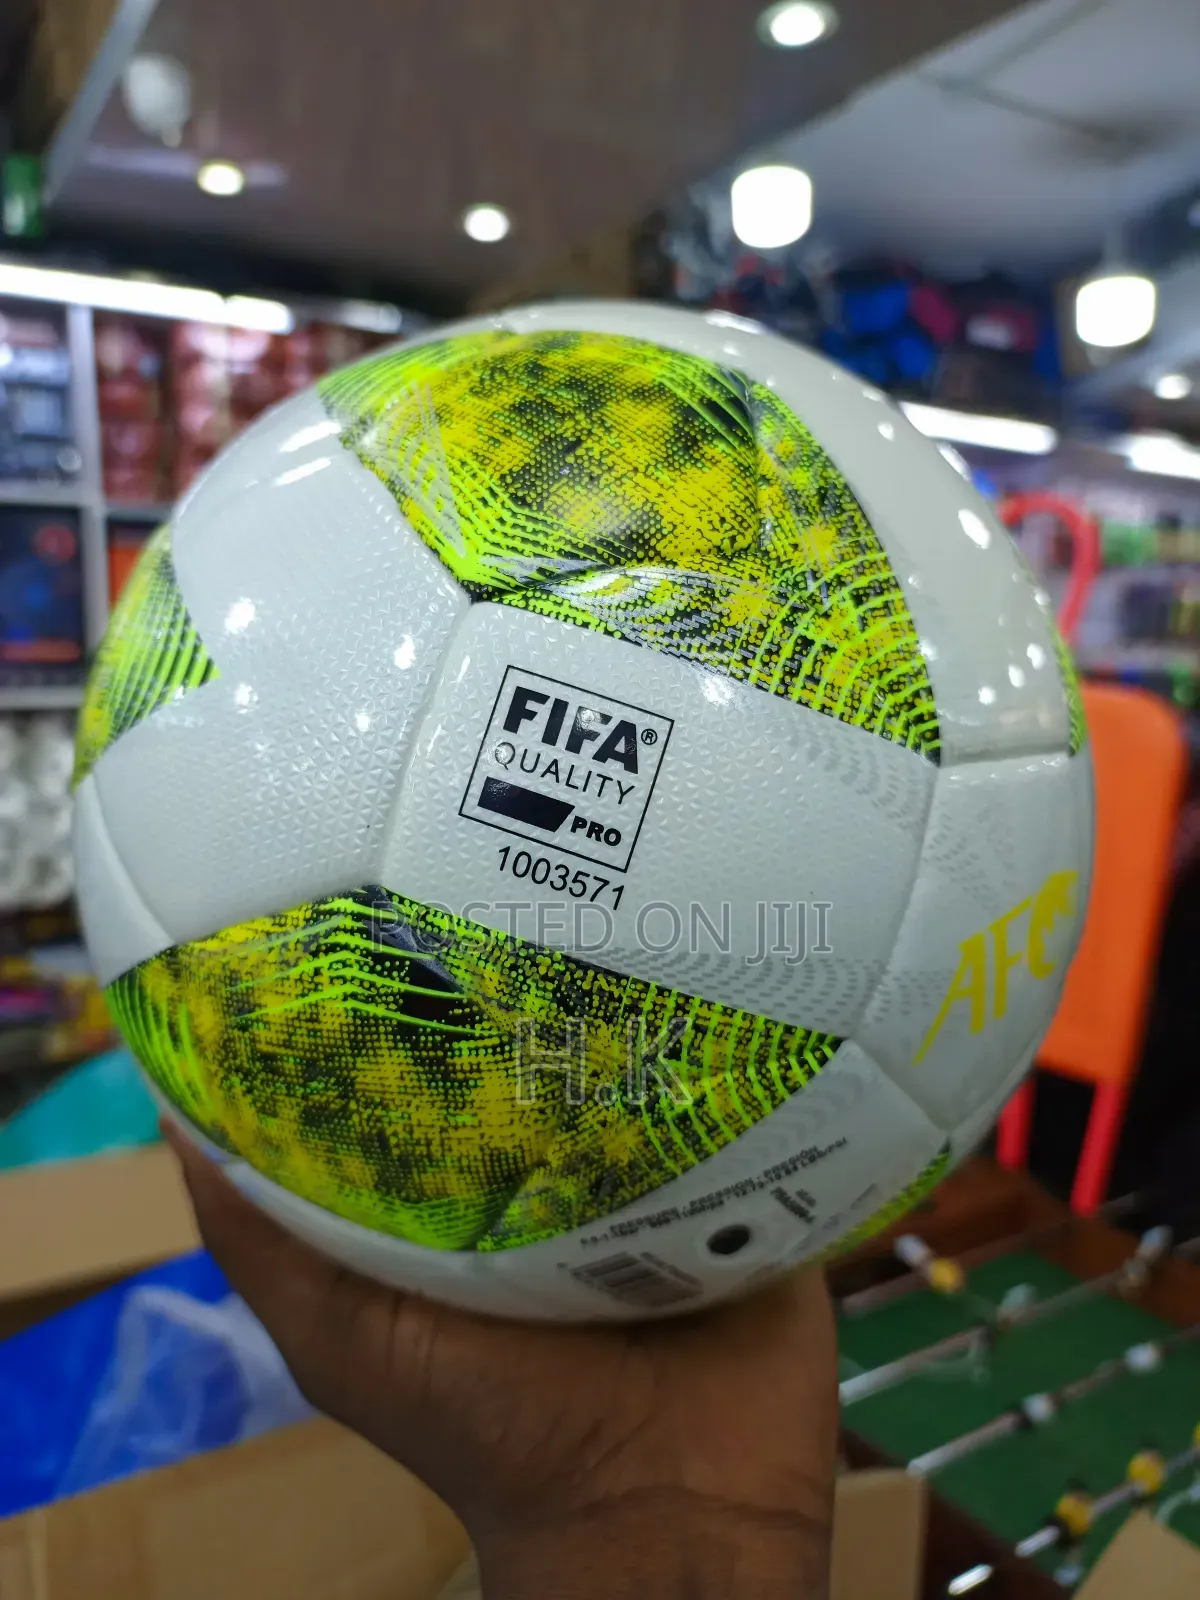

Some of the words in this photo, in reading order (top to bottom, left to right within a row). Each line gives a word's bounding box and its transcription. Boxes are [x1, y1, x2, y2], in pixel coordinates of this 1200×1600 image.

[494, 741, 635, 804] QUALITY
[570, 815, 622, 847] PRO
[498, 846, 625, 911] 1003571
